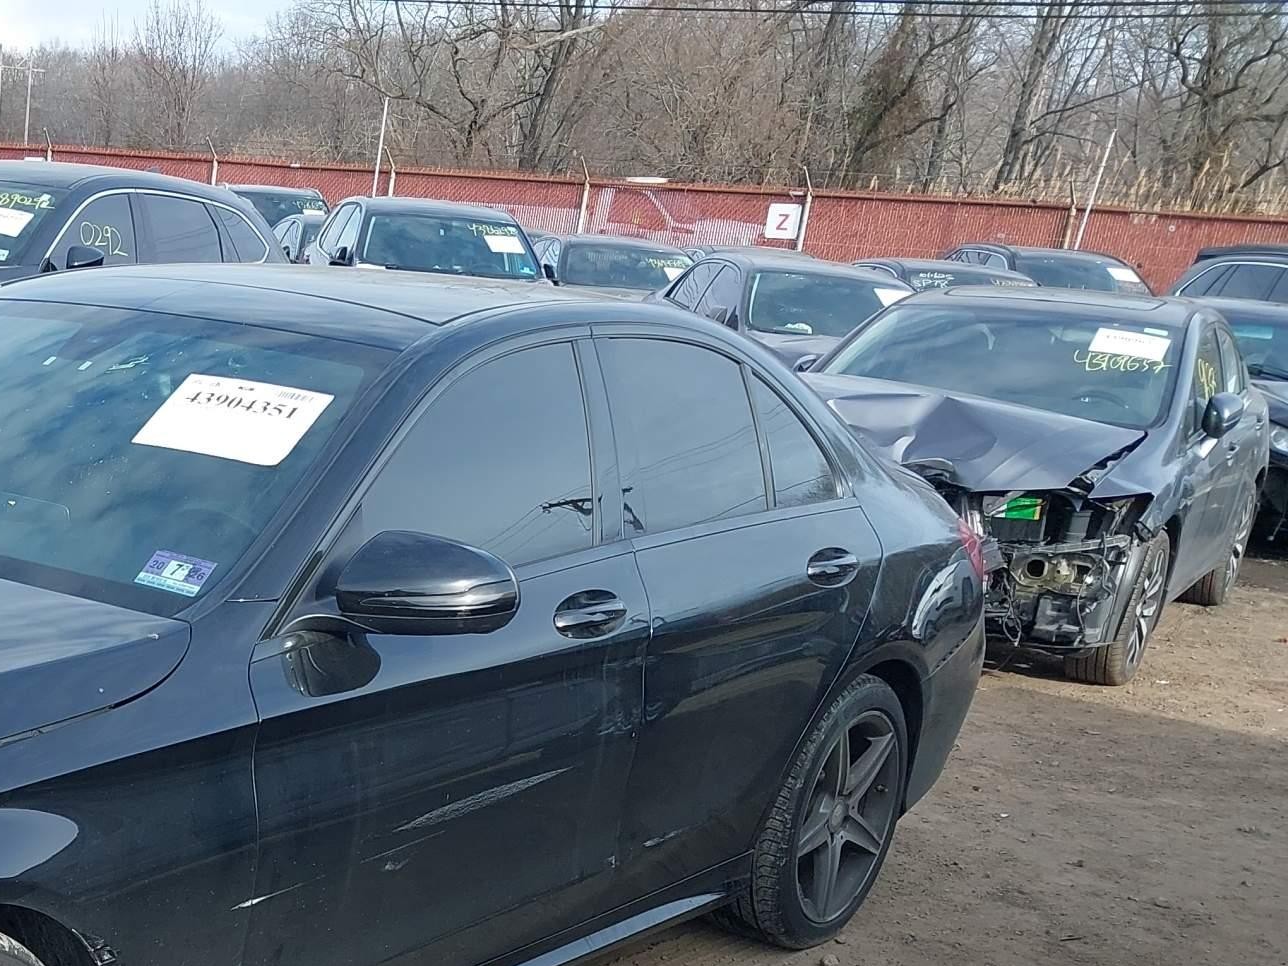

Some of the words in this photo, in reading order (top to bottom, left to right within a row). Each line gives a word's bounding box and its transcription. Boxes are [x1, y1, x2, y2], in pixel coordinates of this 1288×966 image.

[775, 213, 791, 230] Z
[80, 221, 129, 256] 0292
[185, 391, 299, 420] 43904351
[149, 560, 165, 570] 20
[171, 563, 184, 576] 7
[189, 567, 206, 581] 26
